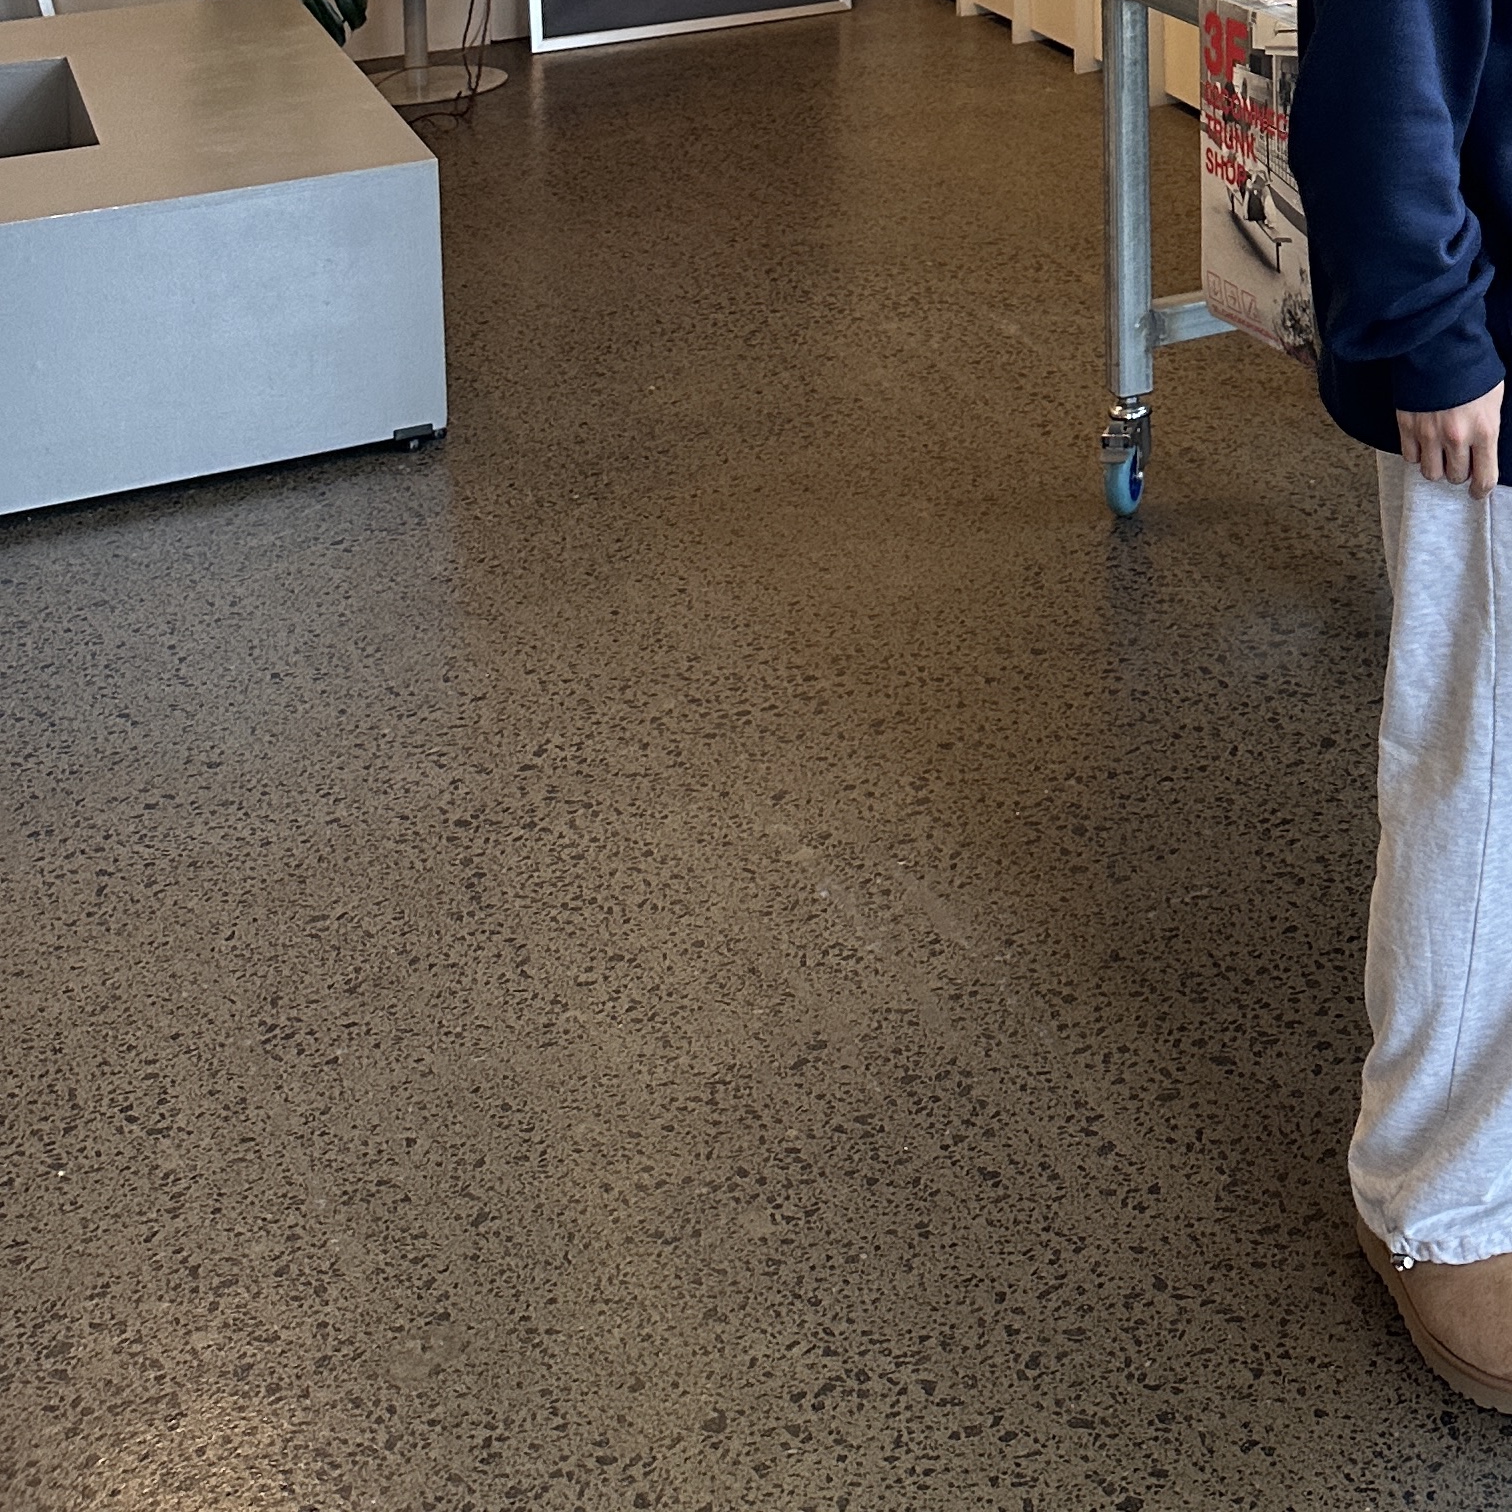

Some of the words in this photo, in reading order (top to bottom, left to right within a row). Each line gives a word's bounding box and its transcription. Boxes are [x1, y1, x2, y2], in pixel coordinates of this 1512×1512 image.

[1204, 11, 1248, 83] 3F
[1205, 112, 1258, 163] TRUNK
[1205, 147, 1247, 188] SHOP
